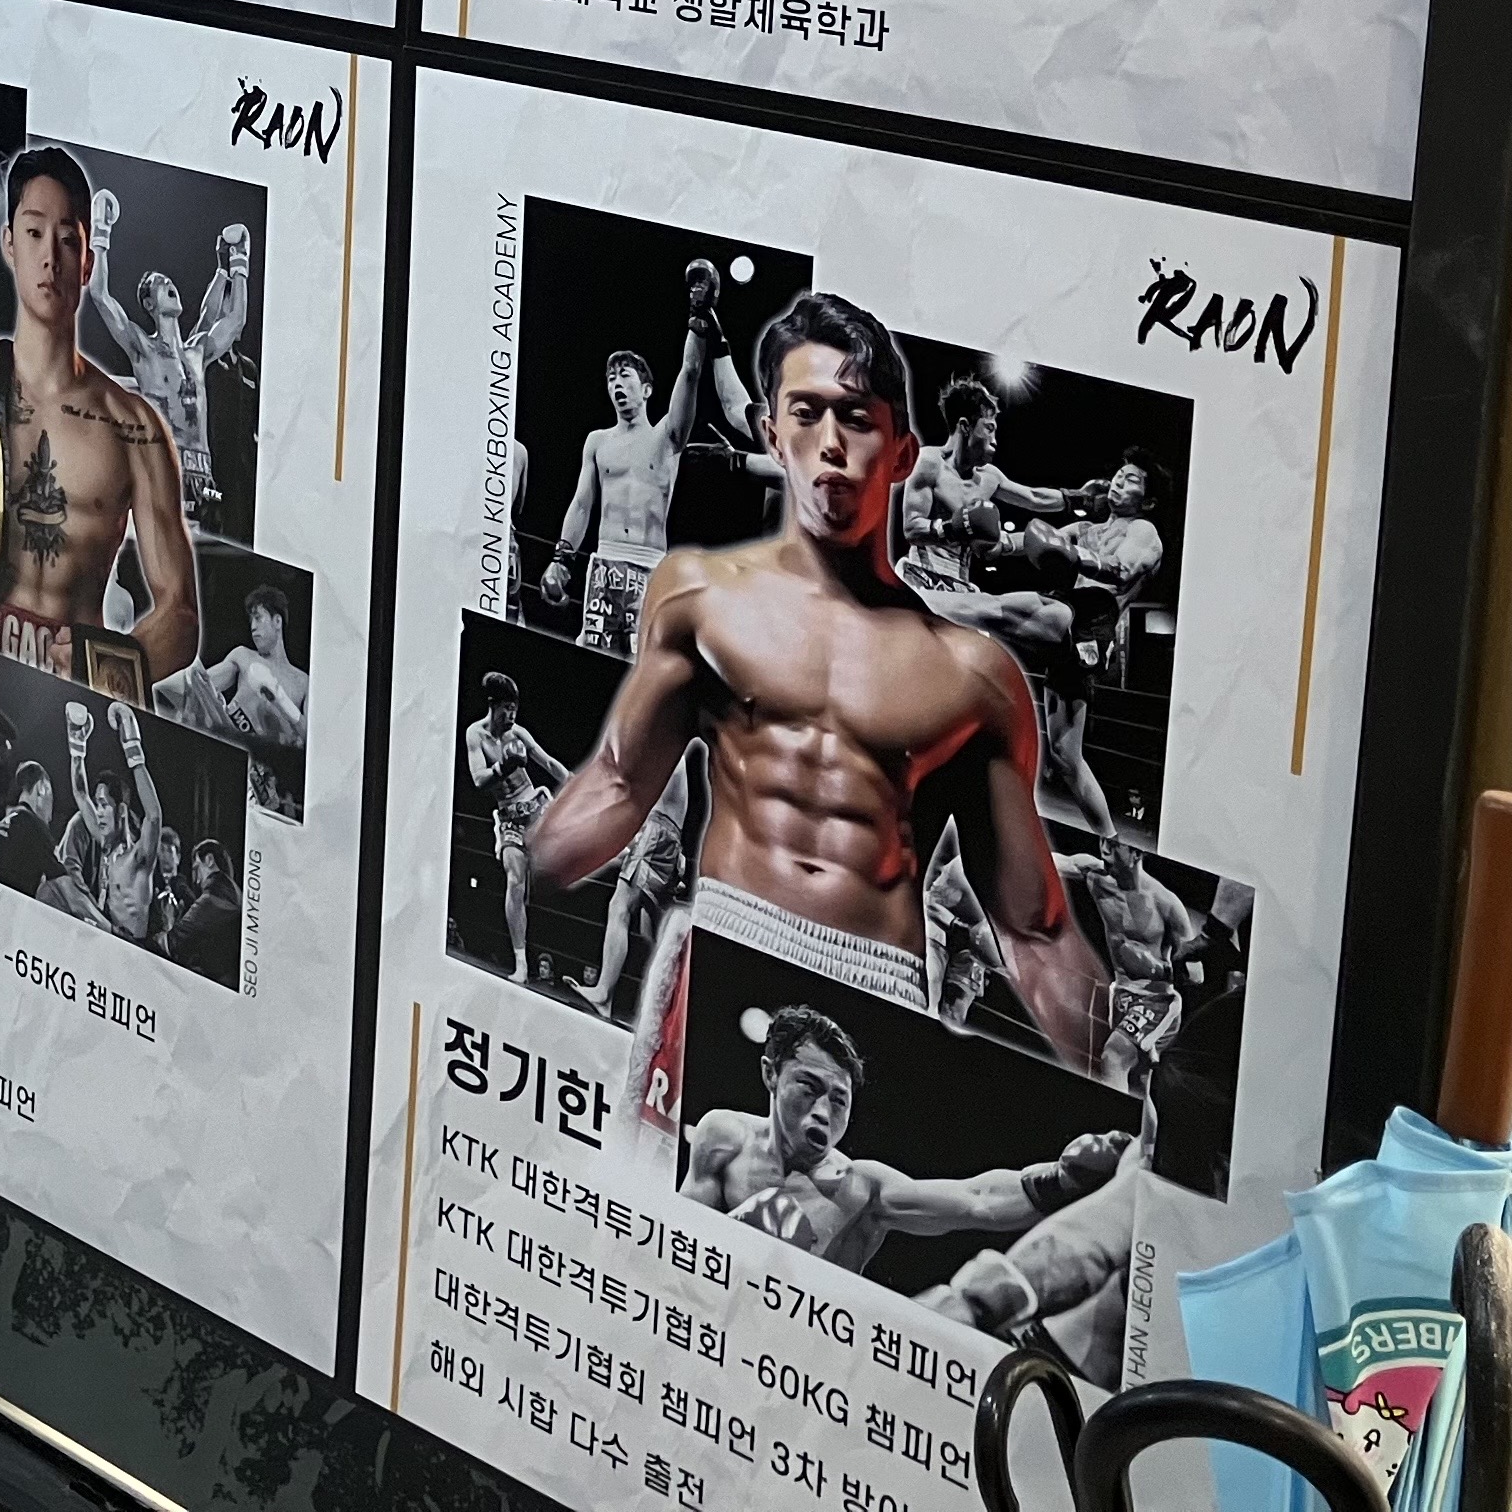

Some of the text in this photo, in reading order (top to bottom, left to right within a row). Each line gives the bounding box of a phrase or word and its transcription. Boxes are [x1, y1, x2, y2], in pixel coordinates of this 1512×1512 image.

[230, 76, 343, 164] RAON
[1138, 256, 1318, 374] RAON
[479, 193, 517, 614] RAON KICKBOXING ACADEMY
[5, 950, 75, 1002] -65KG
[87, 981, 155, 1042] 챔피언
[245, 850, 261, 998] SEO JI MYEONG
[443, 1018, 610, 1149] 정기한
[443, 1125, 978, 1407] KTK 대한격투기협회 -57KG 챔피언
[1128, 1240, 1156, 1378] HAN JEONG
[434, 1267, 645, 1405] 대한격투기협회
[661, 1382, 755, 1462] 챔피언
[771, 1442, 827, 1498] 3차
[438, 1197, 972, 1490] KTK 대한격투기협회 -60KG 챔피언
[431, 1340, 703, 1512] 해외 시합 다수 출전
